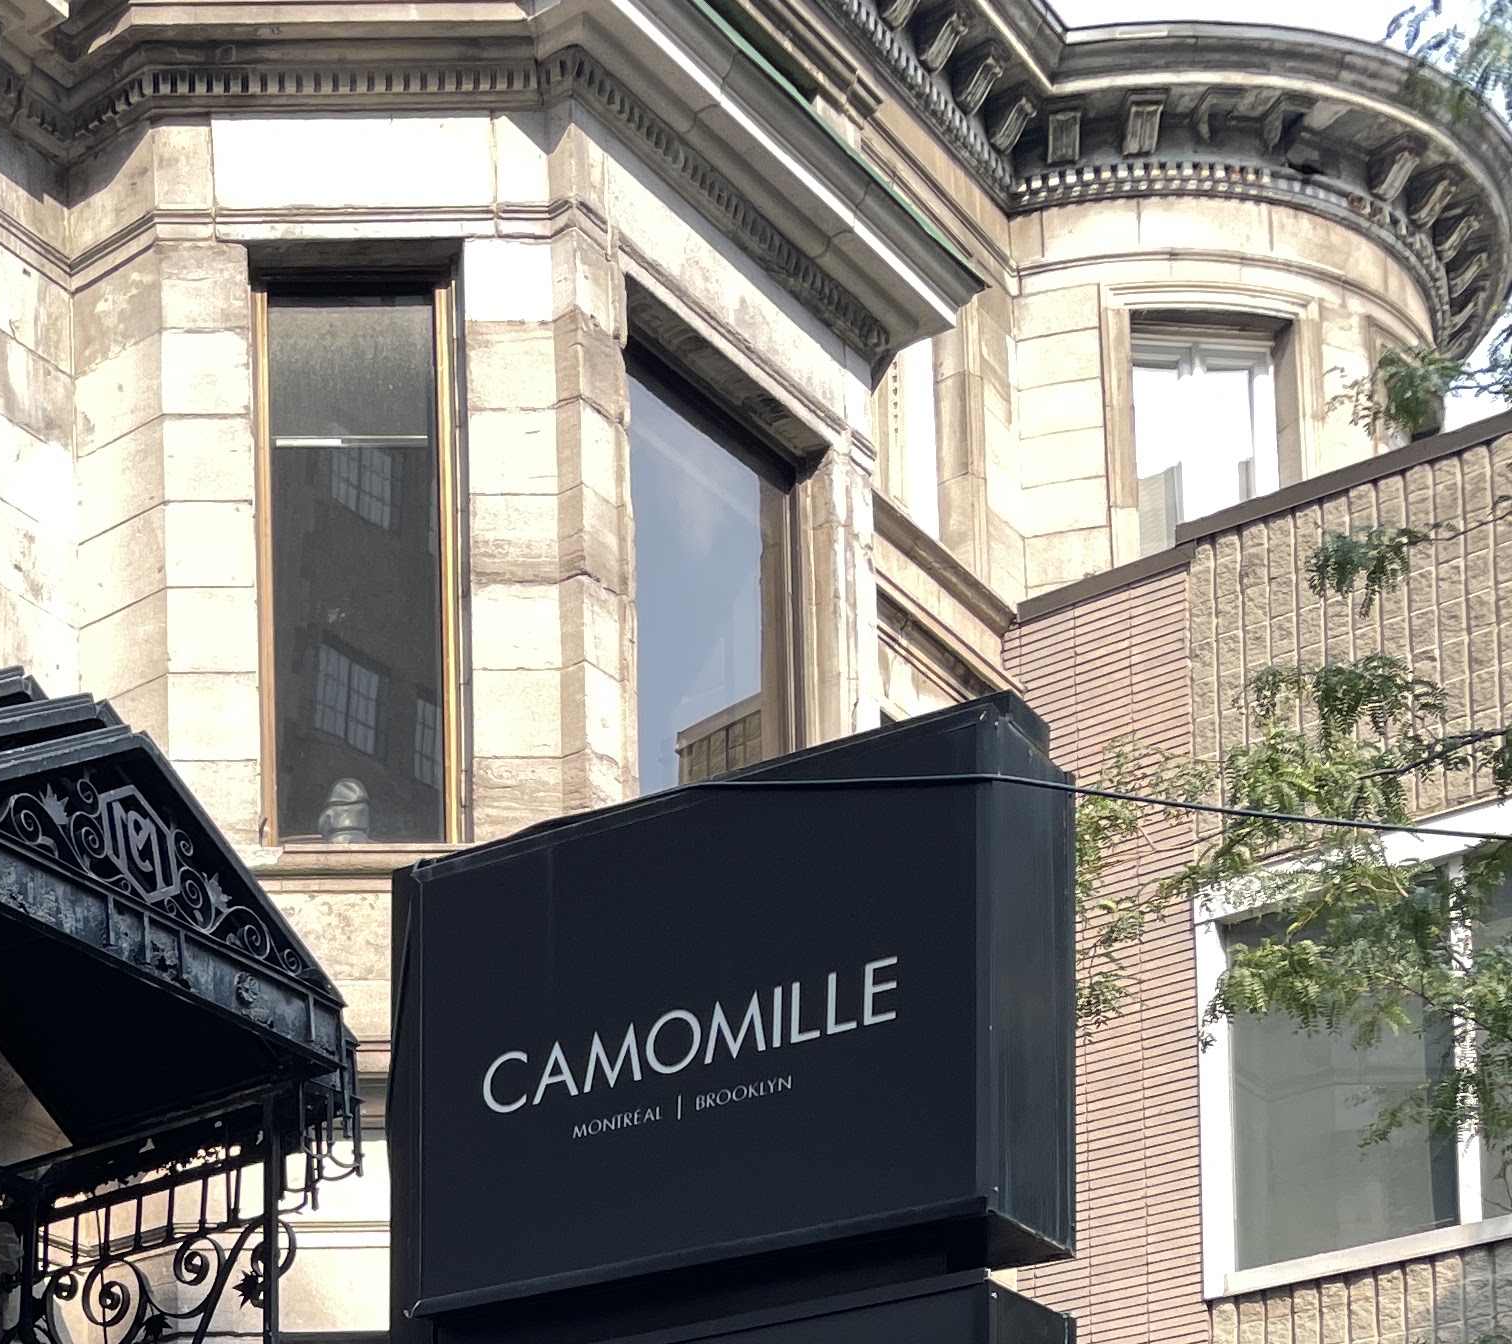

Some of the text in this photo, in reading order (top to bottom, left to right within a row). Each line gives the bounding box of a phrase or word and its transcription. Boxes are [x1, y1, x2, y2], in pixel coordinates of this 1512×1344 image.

[482, 956, 899, 1114] CAMOMILLE
[571, 1075, 792, 1139] MONTRÉAL BROOKLYN
